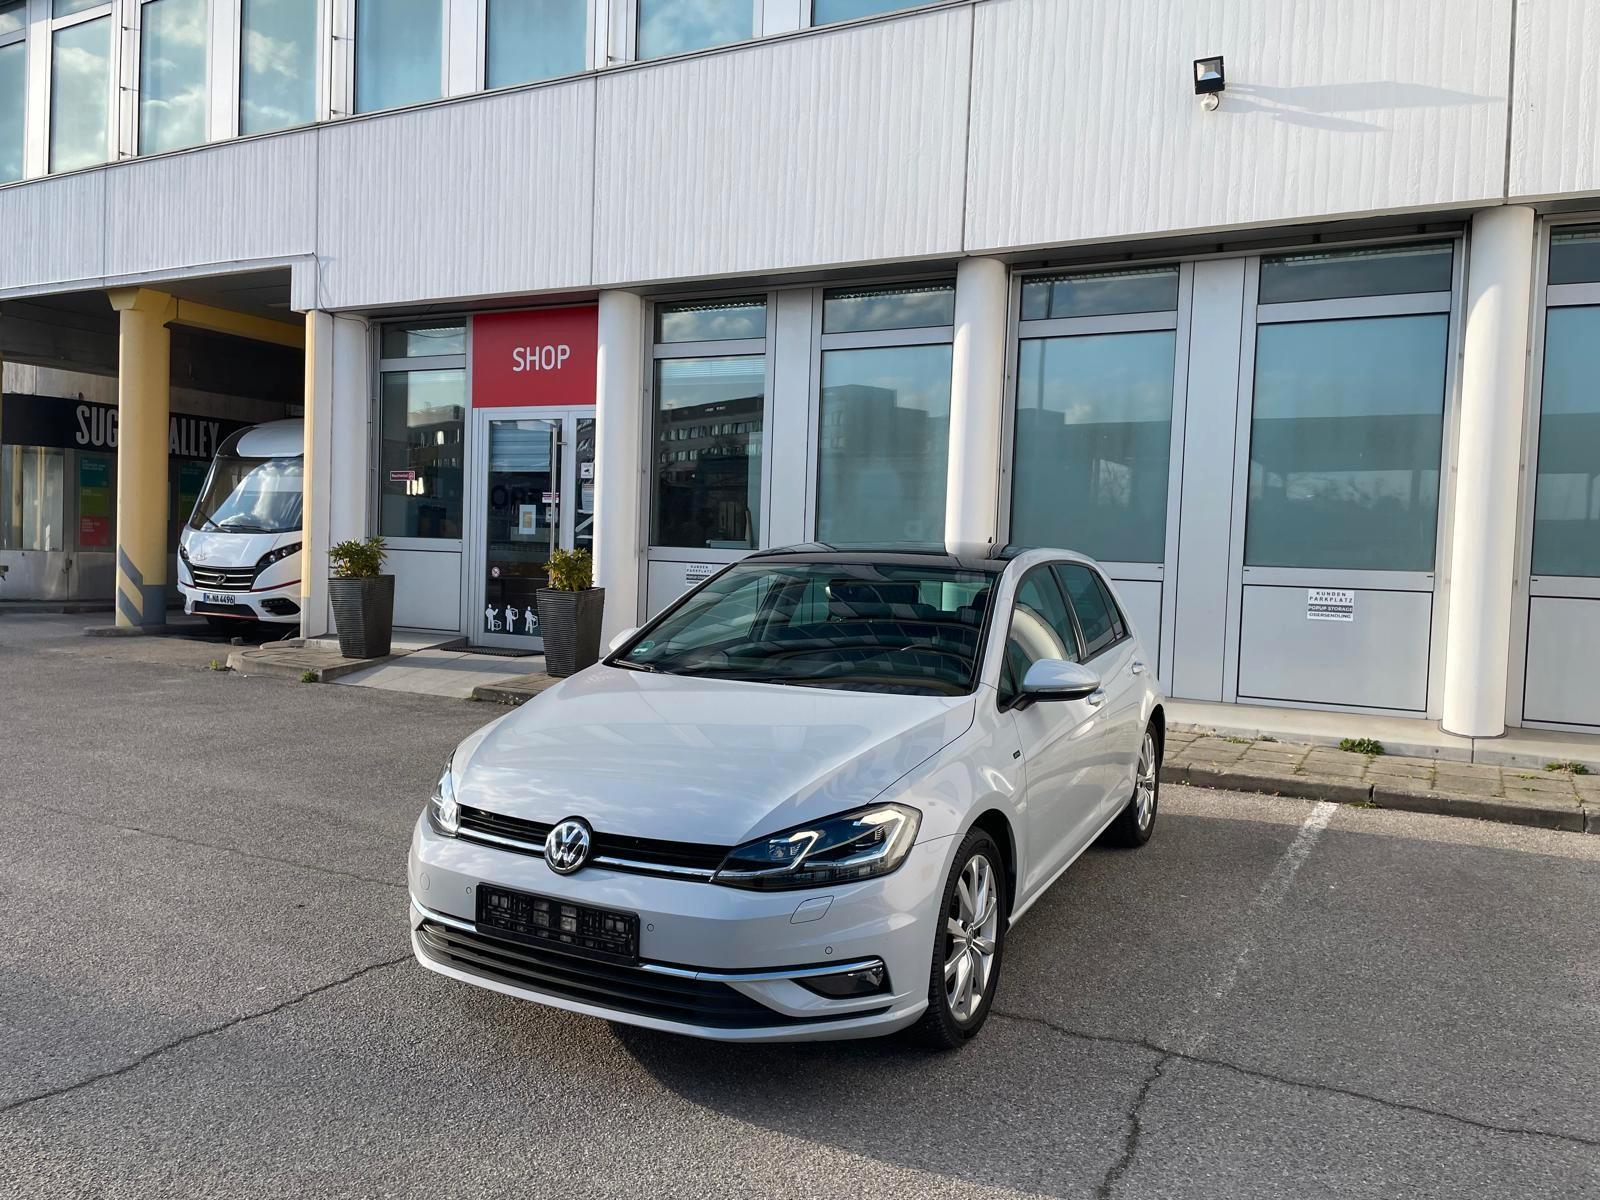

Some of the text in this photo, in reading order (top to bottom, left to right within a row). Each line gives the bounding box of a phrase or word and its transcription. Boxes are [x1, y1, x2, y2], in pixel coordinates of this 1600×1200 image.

[512, 344, 570, 371] SHOP
[75, 404, 220, 458] SUG ALLEY
[1309, 596, 1353, 604] PARKPLATZ
